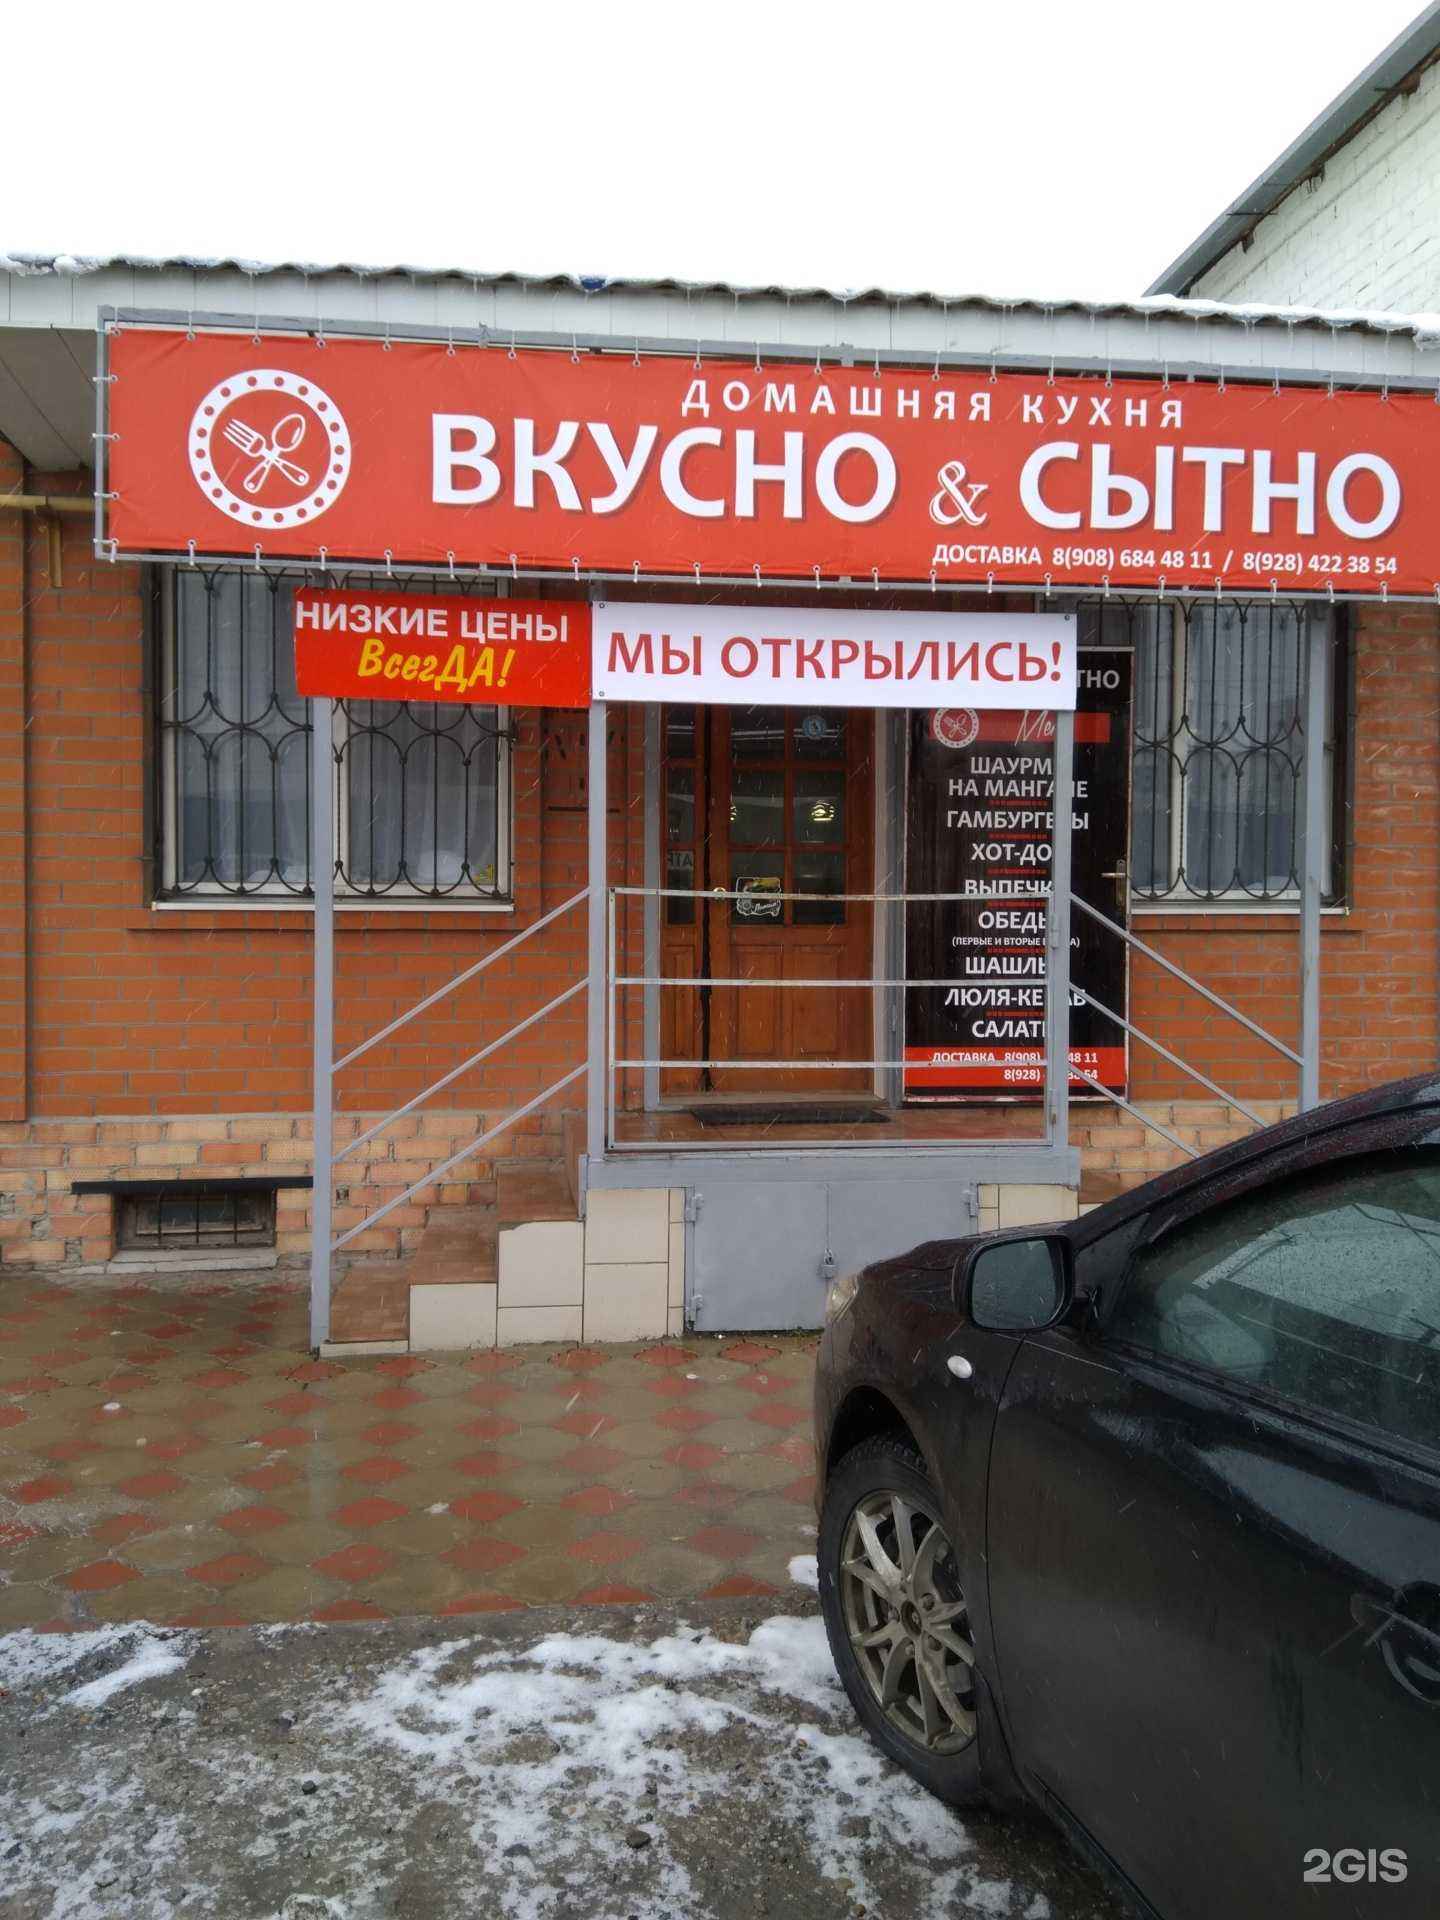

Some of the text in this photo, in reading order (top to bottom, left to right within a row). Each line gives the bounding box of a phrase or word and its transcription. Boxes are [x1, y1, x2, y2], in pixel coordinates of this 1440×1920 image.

[681, 378, 1184, 429] ДОМАШНЯЯ КУХНЯ
[431, 412, 1401, 540] ВКУСНО & СЫТНО
[932, 543, 1397, 574] ДОСТАВКА 8(908) 684 48 11 / 8(928) 422 38 54
[296, 600, 568, 645] НИЗКИЕ ЦЕНЫ
[357, 637, 515, 693] ВсегДА!
[606, 632, 1061, 682] МЫ ОТКРЫЛИСЬ!
[1076, 669, 1120, 689] ТНО
[970, 756, 1052, 775] ШАУРМ
[948, 778, 979, 797] НА
[947, 810, 1089, 830] ГАМБУРГЕЫ
[971, 843, 1052, 866] ХОТ-ДО
[964, 879, 1054, 895] ВЫПЕЧК
[952, 936, 993, 947] (ПЕРВЫЕ
[995, 937, 1001, 945] И
[1004, 937, 1040, 946] ВТОРЫЕ
[965, 956, 1046, 975] ШАШЛ
[945, 988, 1087, 1006] ЛЮЛЯ-КЕБ
[972, 1020, 1045, 1038] САЛАТ
[932, 1052, 995, 1062] ДОСТАВКА
[1084, 1052, 1098, 1063] 11
[1004, 1069, 1040, 1081] 8(928)
